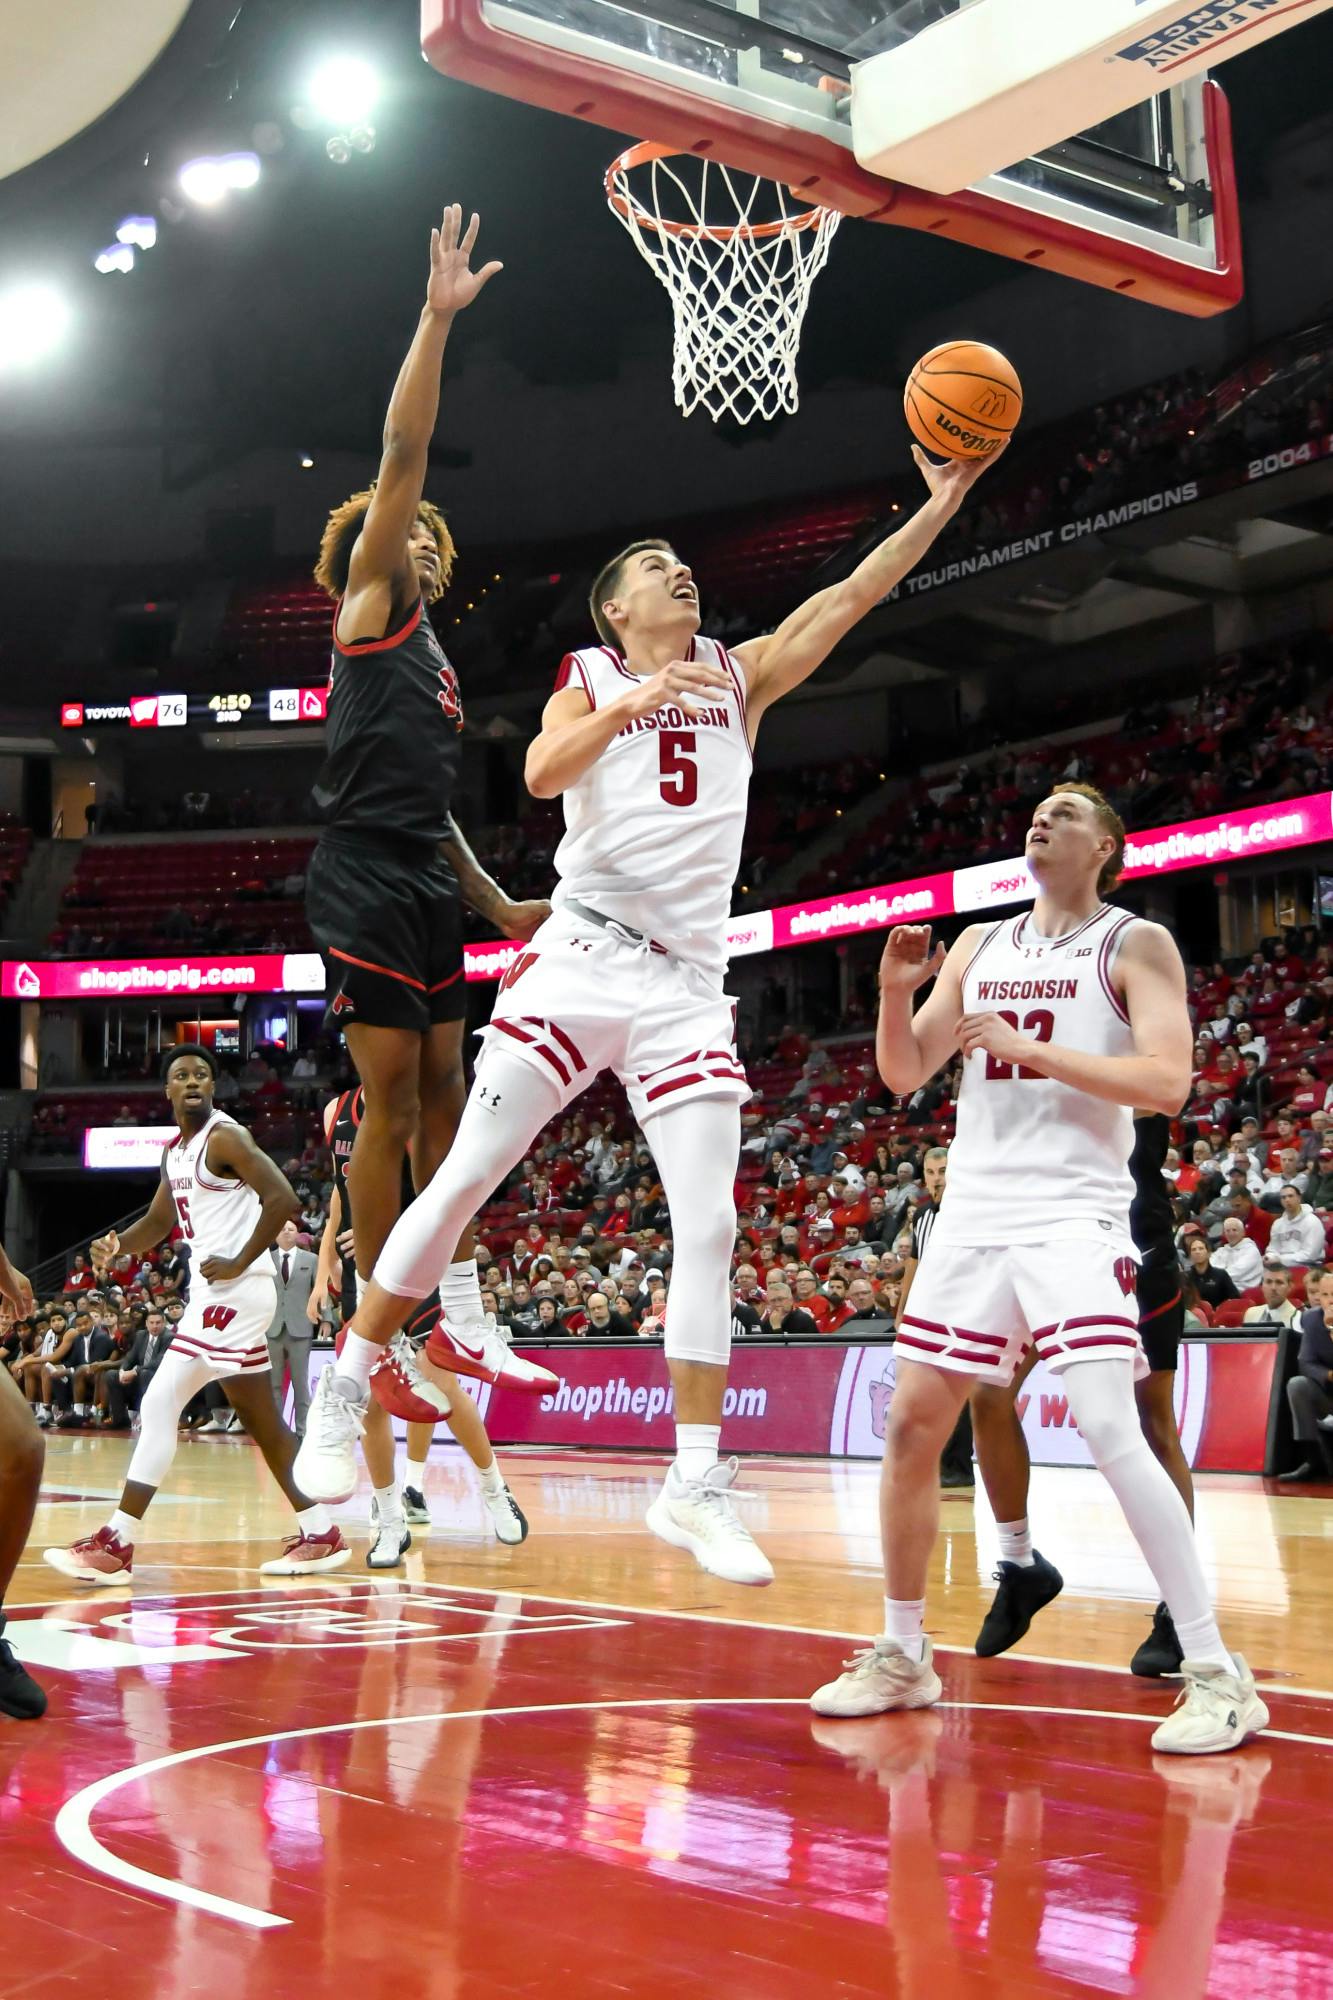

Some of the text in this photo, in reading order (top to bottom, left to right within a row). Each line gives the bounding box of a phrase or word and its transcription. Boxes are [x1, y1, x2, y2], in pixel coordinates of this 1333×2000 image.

[1144, 12, 1248, 68] FAMILY
[935, 413, 1002, 452] Wilson
[1248, 443, 1312, 479] 2004
[906, 482, 1198, 593] TOURNAMENT CHAMPIONS
[85, 706, 132, 719] TOYOTA
[163, 703, 184, 717] 76
[208, 694, 252, 711] 4:50
[216, 710, 242, 723] 2ND
[274, 698, 297, 711] 48
[659, 730, 698, 807] 5
[790, 890, 933, 935] shopthepig.com
[79, 964, 256, 992] shopthepig.com
[977, 979, 1079, 1000] WISCONSIN
[540, 1377, 767, 1422] shopthepiom
